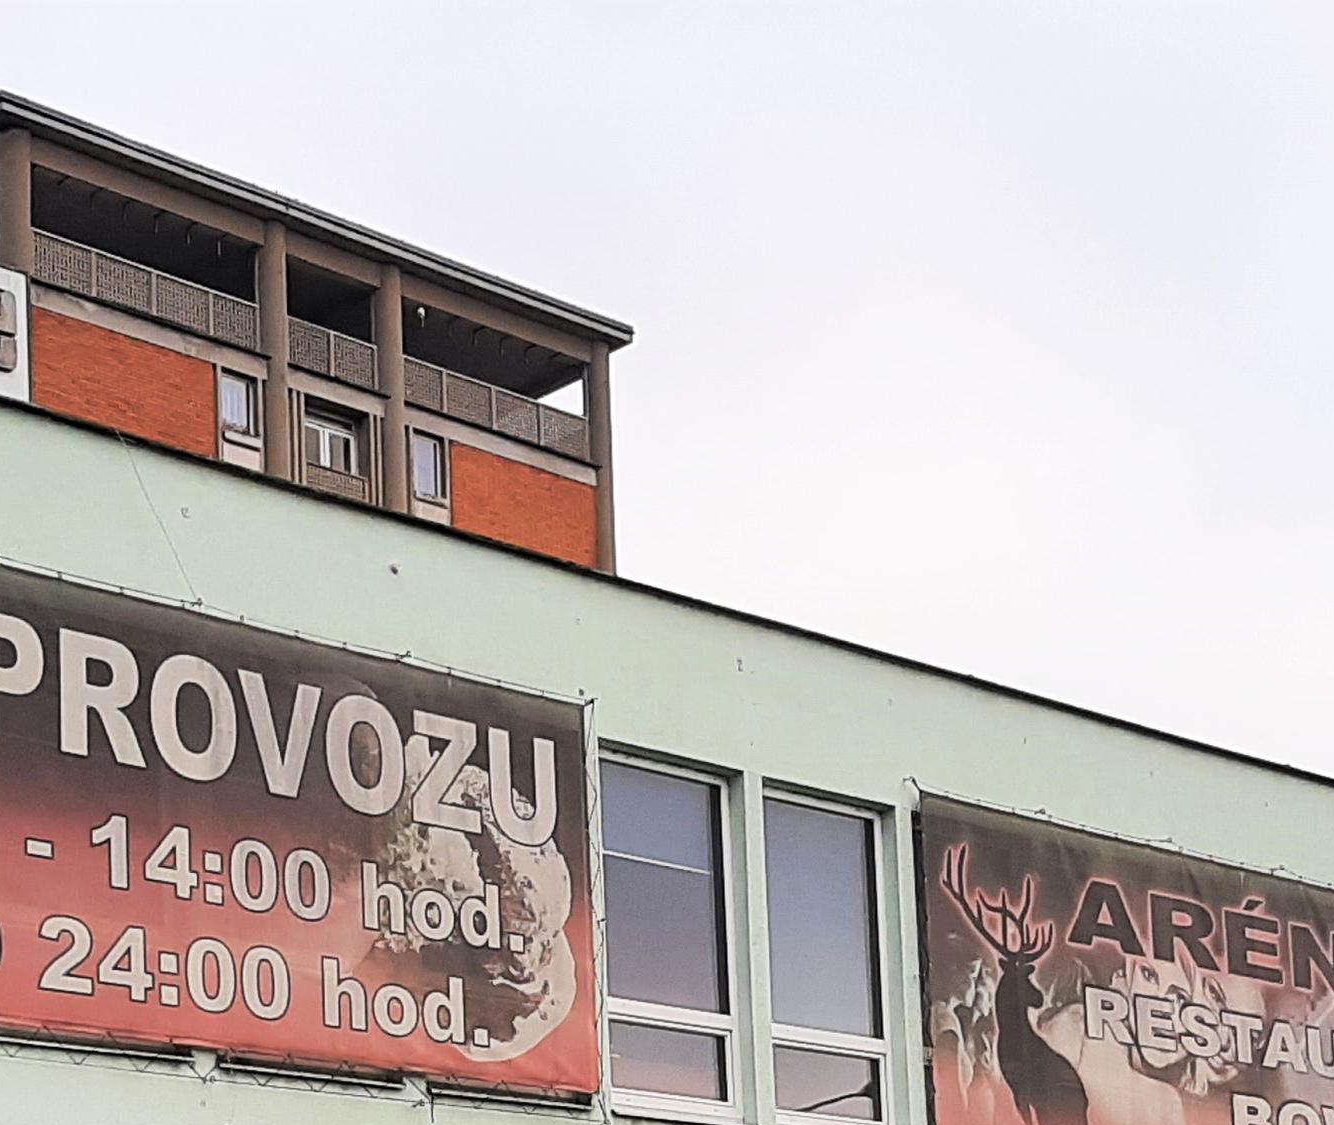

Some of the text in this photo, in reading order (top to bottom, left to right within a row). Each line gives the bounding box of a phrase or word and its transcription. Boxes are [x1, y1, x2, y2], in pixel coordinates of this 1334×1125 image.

[24, 837, 55, 860] -
[89, 813, 332, 922] 14:00
[361, 860, 525, 953] hod.
[38, 916, 291, 1022] 24:00
[320, 955, 492, 1049] hod.
